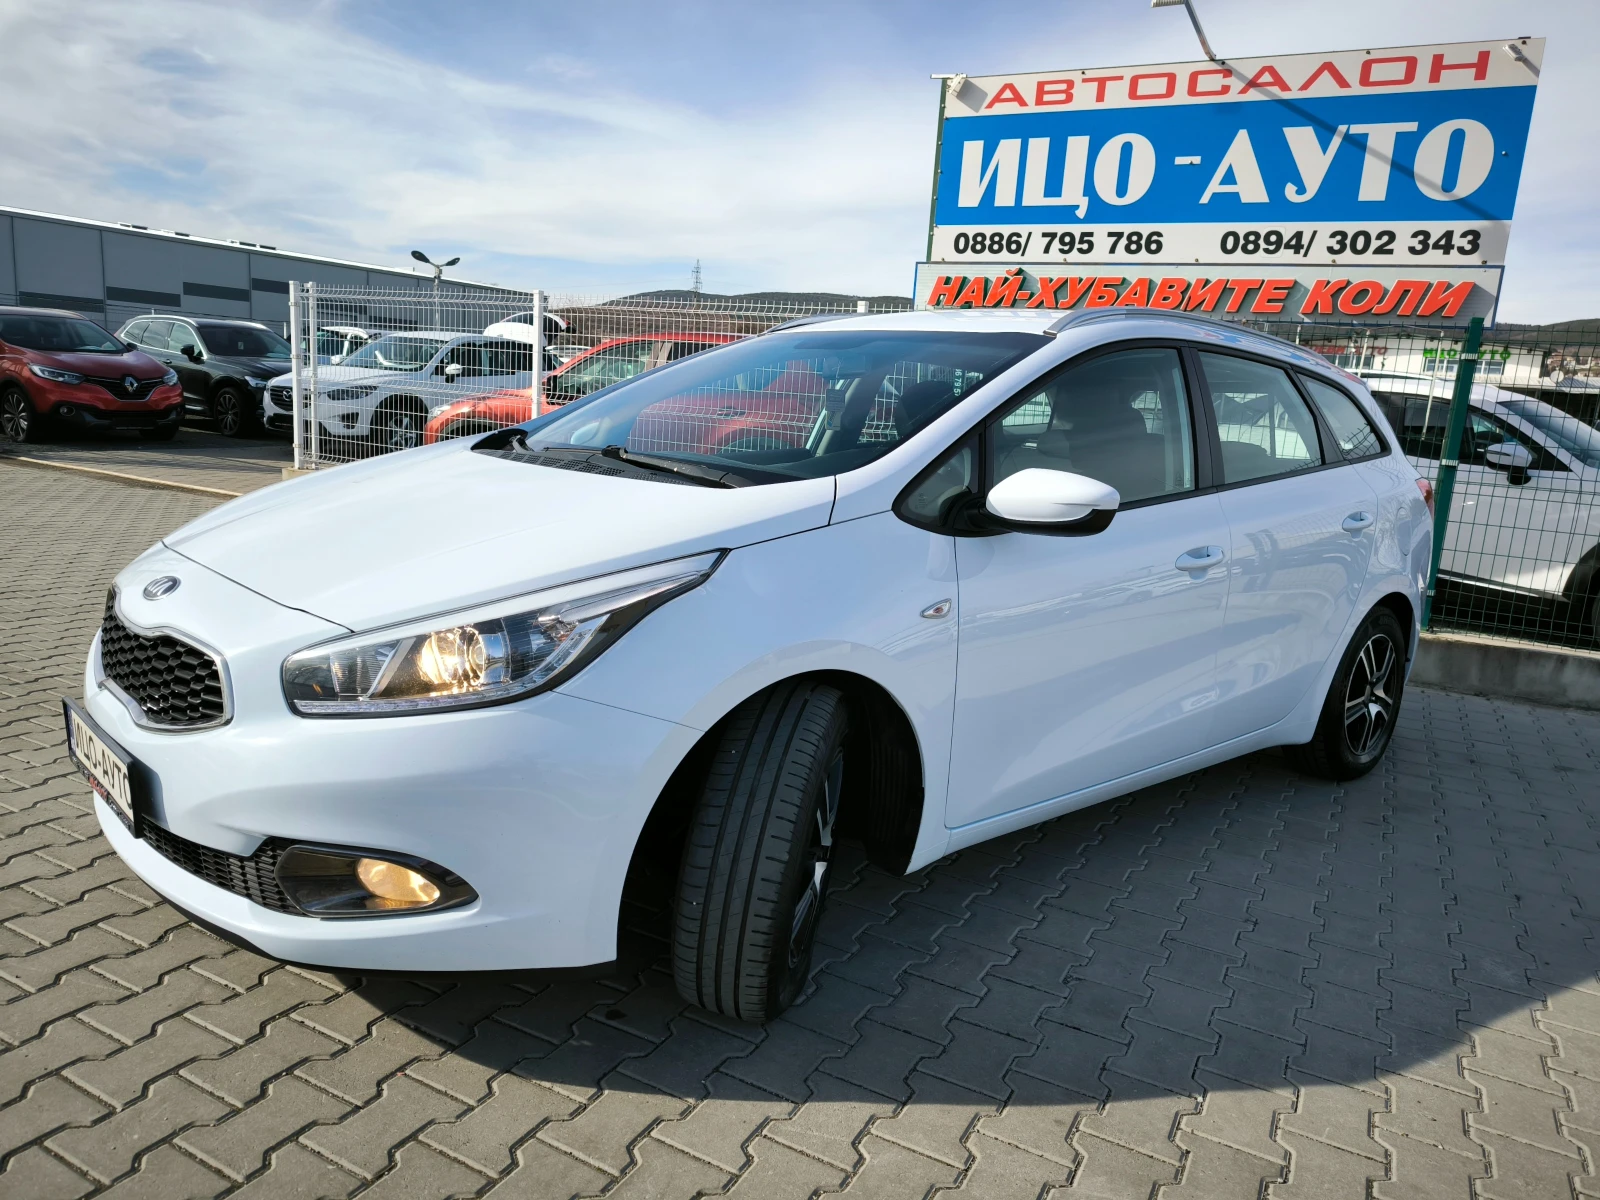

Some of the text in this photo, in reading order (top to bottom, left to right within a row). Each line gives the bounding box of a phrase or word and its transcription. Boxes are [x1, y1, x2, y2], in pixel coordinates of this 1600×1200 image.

[985, 51, 1491, 109] АВТОСАЛОН
[1041, 231, 1094, 254] 795
[1107, 231, 1164, 254] 786
[1326, 230, 1396, 255] 302
[1408, 229, 1481, 255] 343
[927, 267, 1475, 317] НАЙ-ХУБАВИТЕ КОЛИ
